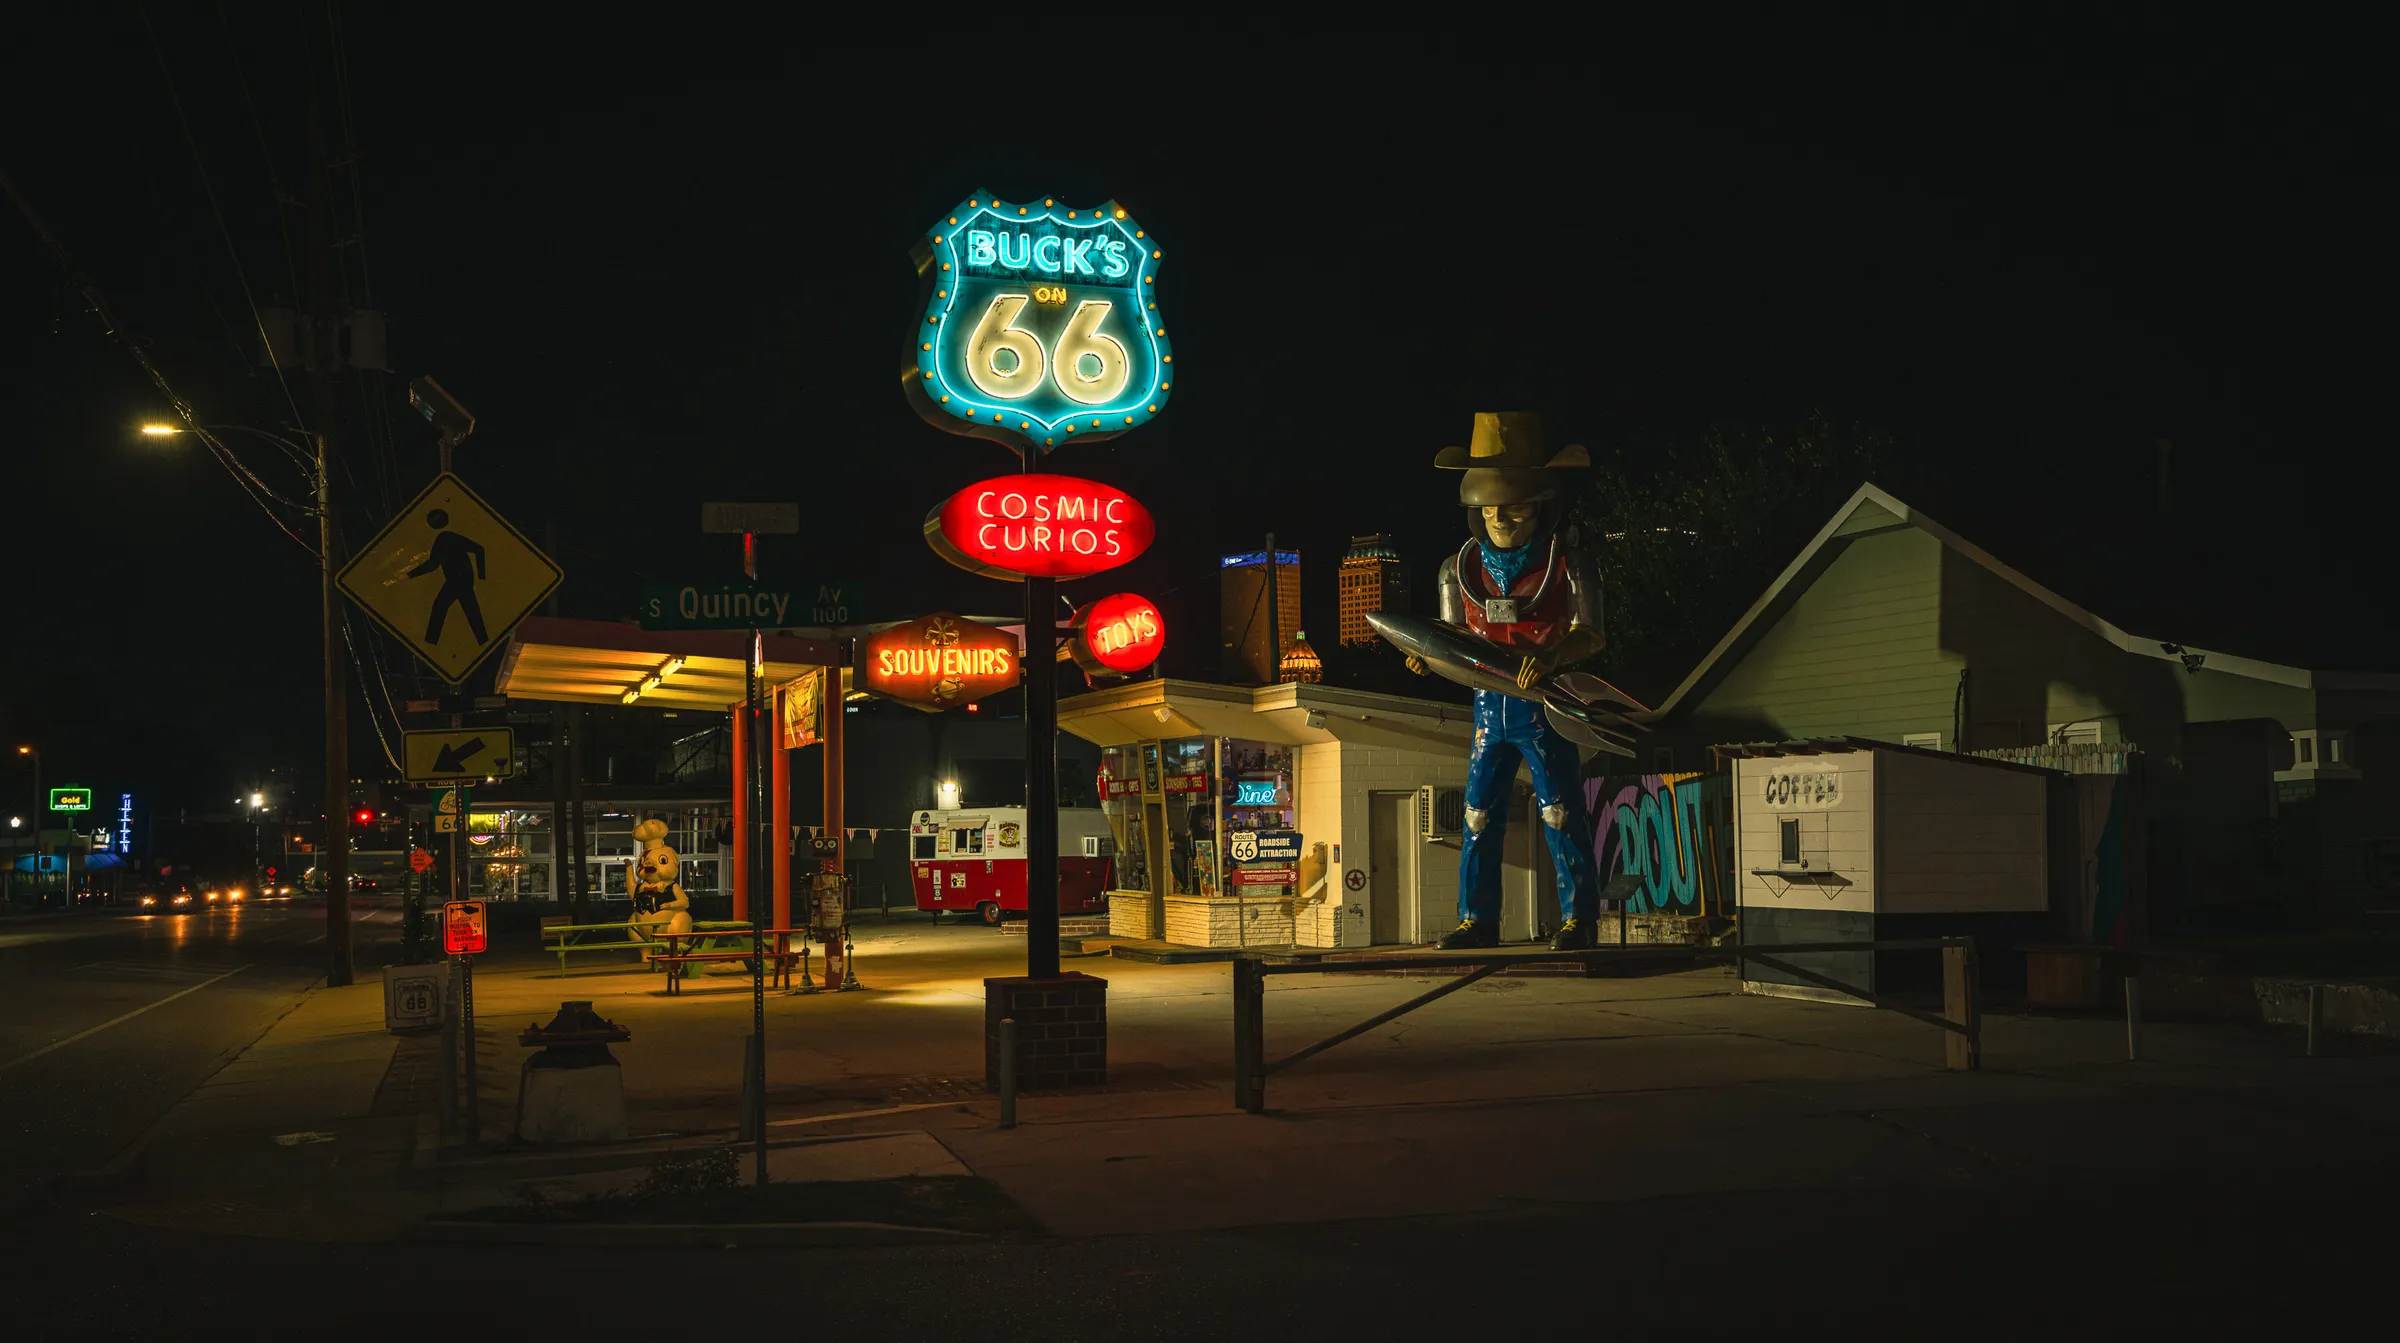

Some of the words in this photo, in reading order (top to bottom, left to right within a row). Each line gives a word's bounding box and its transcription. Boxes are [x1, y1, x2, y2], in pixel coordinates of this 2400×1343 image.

[967, 230, 1130, 278] BUCK'S
[1034, 287, 1067, 305] ON
[965, 293, 1130, 405] 66
[977, 491, 1124, 524] COSMIC
[978, 523, 1121, 556] CURIOS
[648, 597, 661, 618] S
[679, 586, 790, 625] Quincy
[812, 606, 849, 623] 1100
[1096, 609, 1158, 654] TOYS
[878, 648, 1010, 676] SOUVENIRS
[61, 796, 80, 804] Gold
[1765, 773, 1839, 805] COFFEE
[1235, 842, 1254, 858] 66
[1259, 838, 1291, 847] ROADSIDE
[1259, 848, 1298, 858] ATTRACTION
